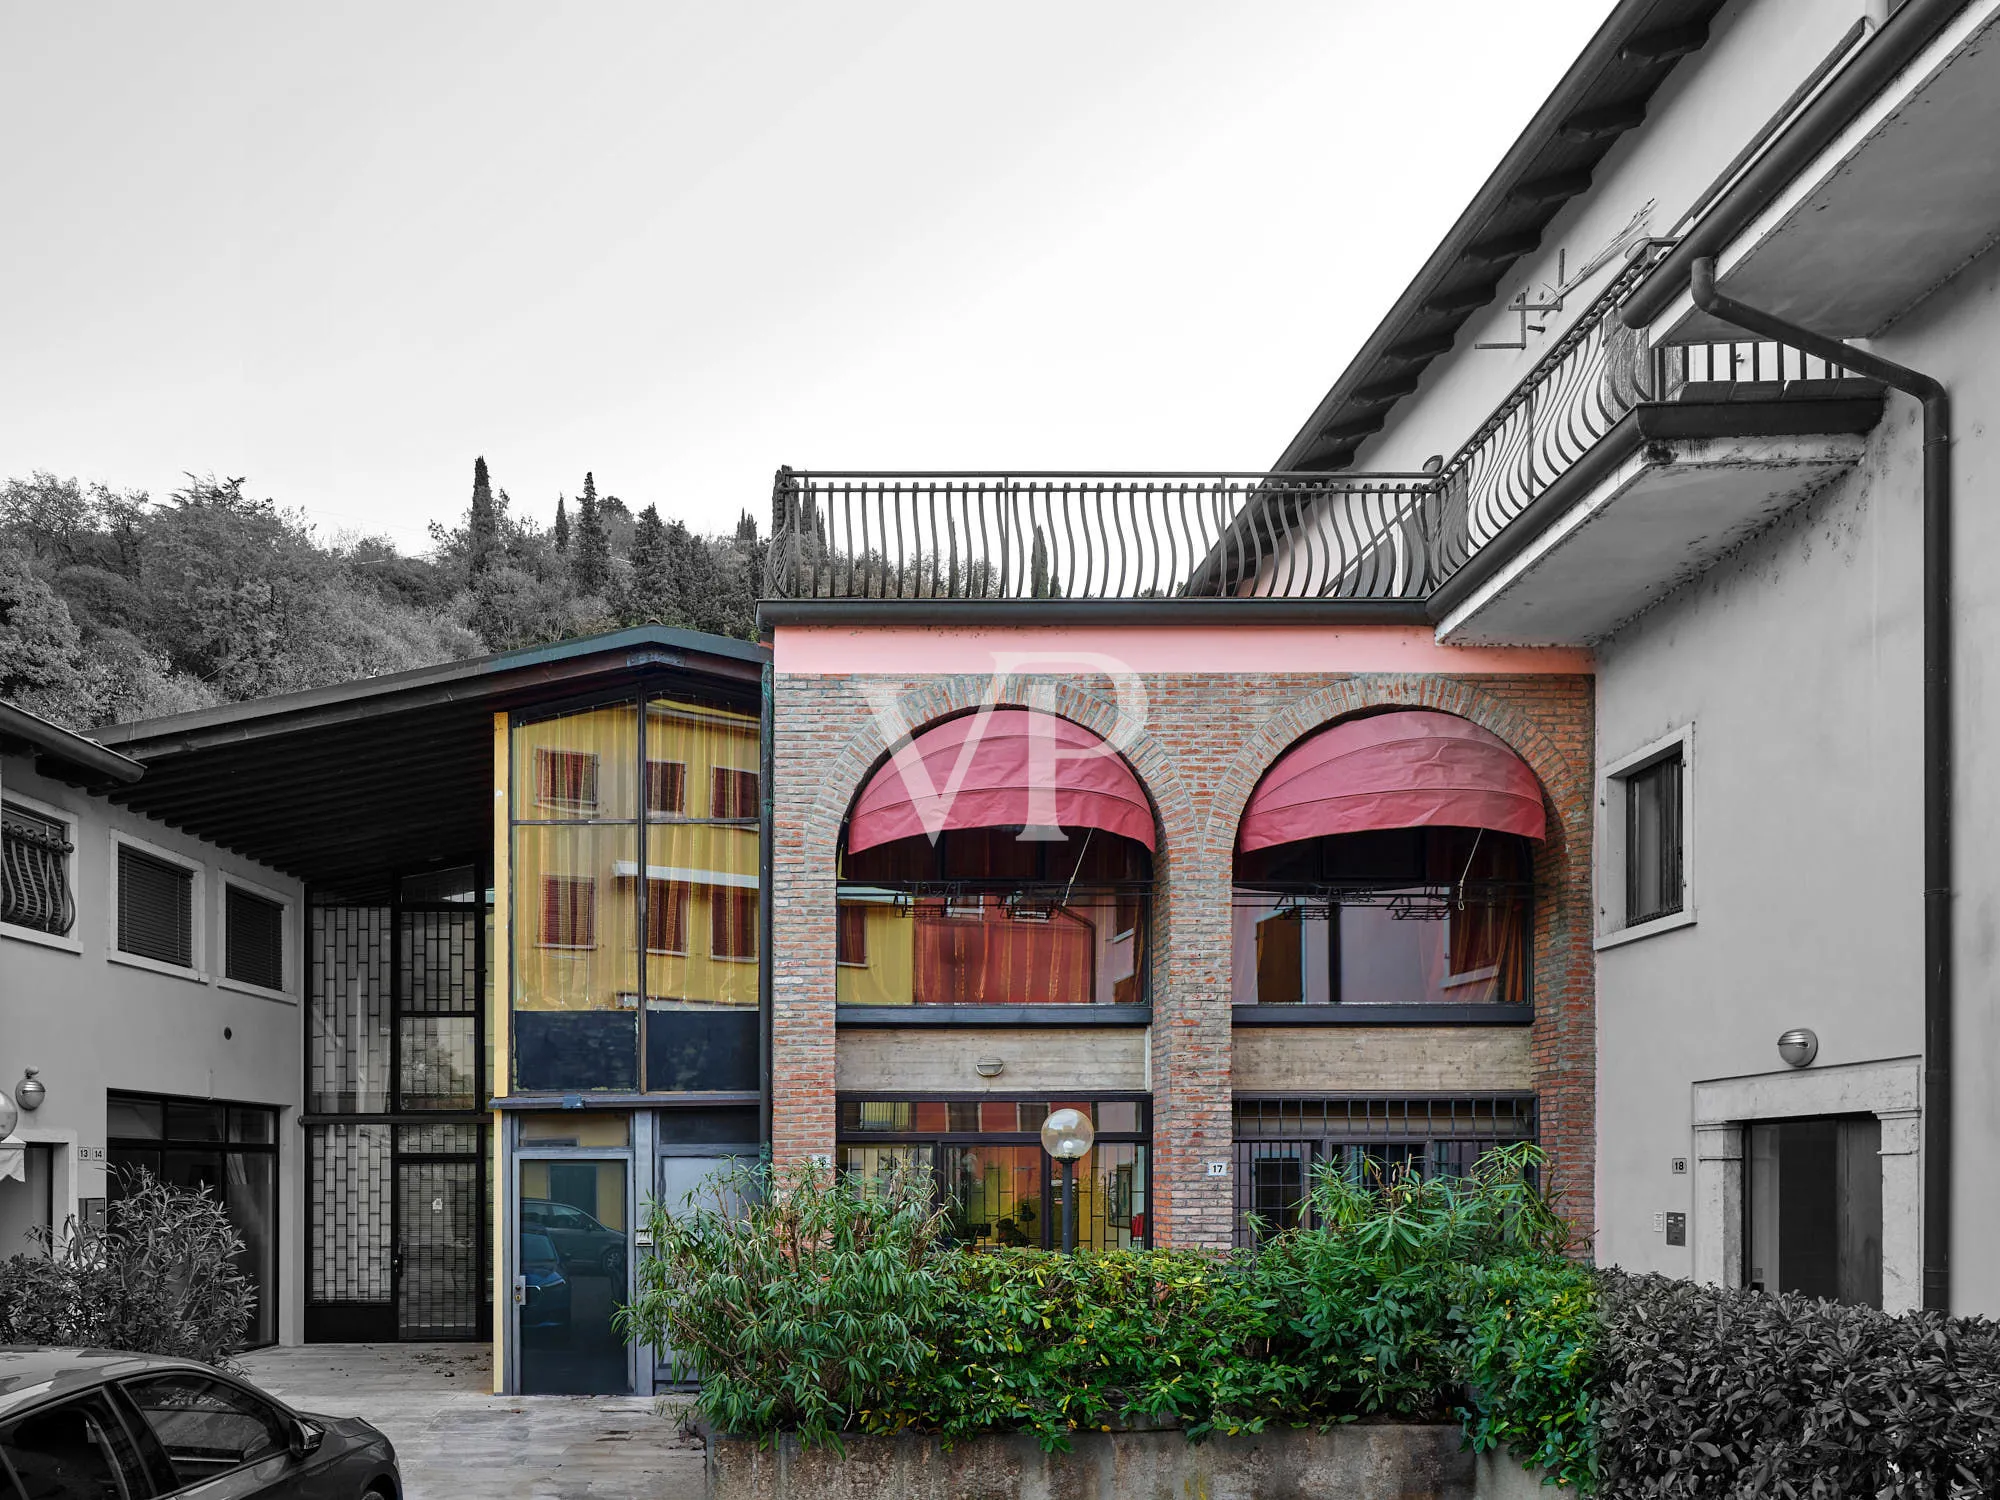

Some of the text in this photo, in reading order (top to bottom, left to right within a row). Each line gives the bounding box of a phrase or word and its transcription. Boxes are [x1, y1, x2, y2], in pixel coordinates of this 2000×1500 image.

[80, 1149, 88, 1158] 13
[95, 1150, 102, 1158] 14
[1213, 1165, 1222, 1173] 17
[1675, 1161, 1684, 1170] 18
